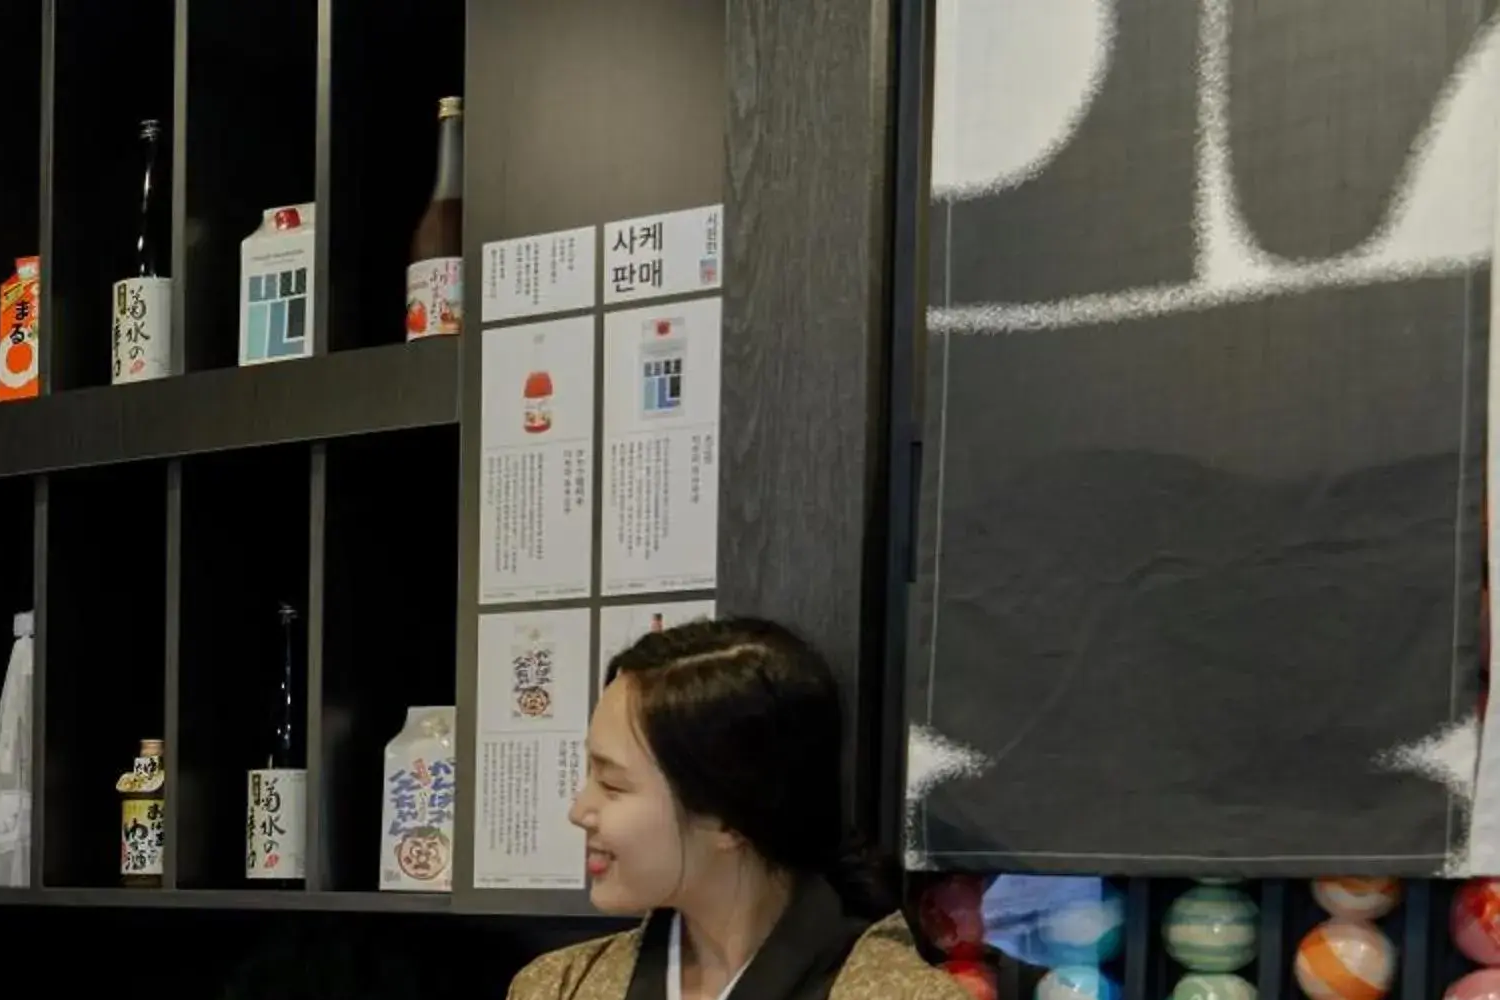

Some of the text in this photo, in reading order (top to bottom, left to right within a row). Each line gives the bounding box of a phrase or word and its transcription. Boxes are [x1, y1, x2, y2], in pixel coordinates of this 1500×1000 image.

[612, 222, 663, 255] 사케
[612, 259, 663, 293] 판매
[10, 300, 29, 345] まる
